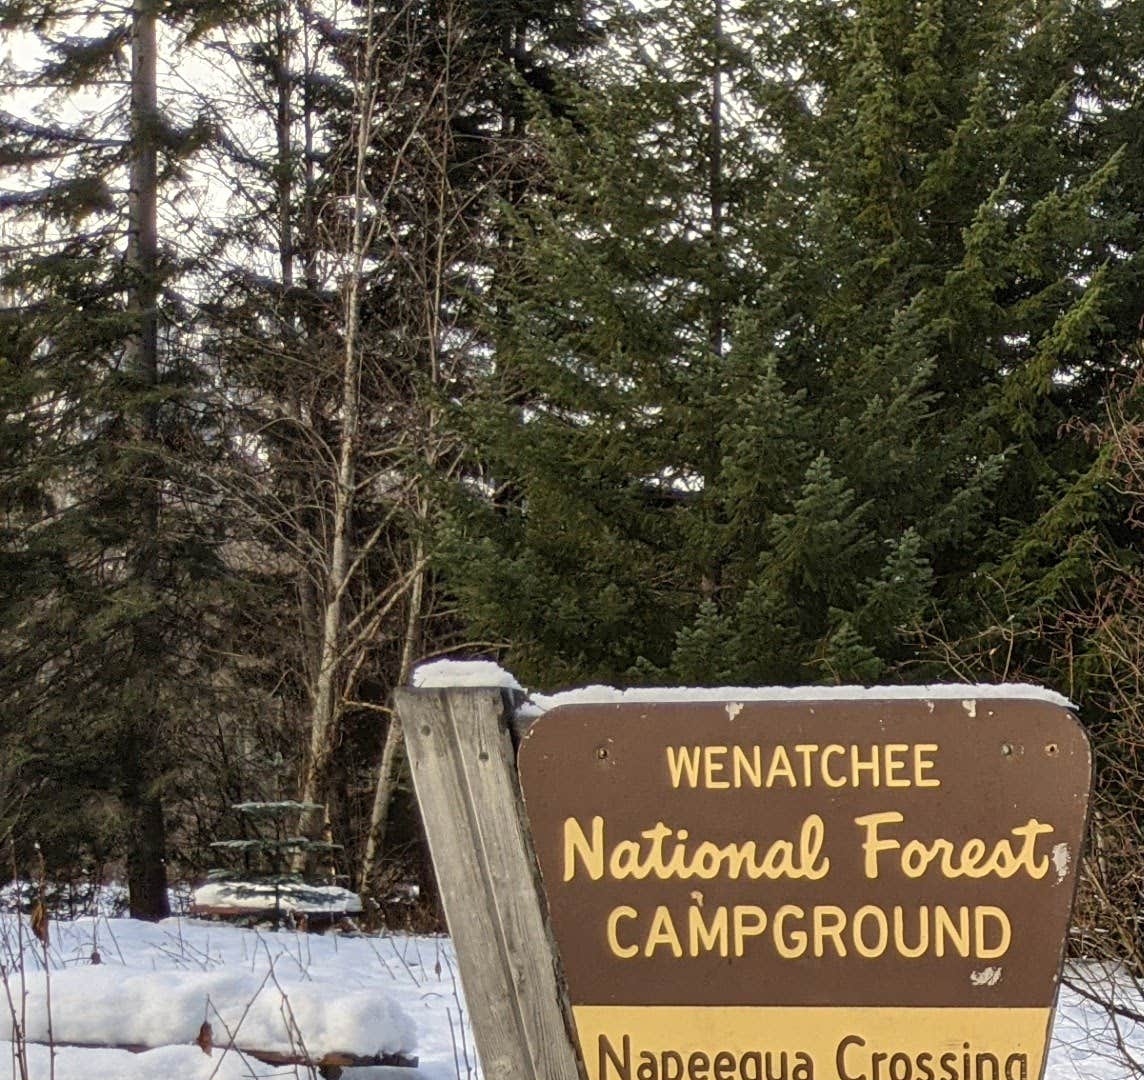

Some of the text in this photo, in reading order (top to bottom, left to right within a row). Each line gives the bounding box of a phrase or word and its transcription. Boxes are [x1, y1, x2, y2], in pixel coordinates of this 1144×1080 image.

[666, 743, 941, 789] WENATCHEE
[563, 811, 1053, 882] National Forest
[606, 905, 1012, 958] CAMPGROUND
